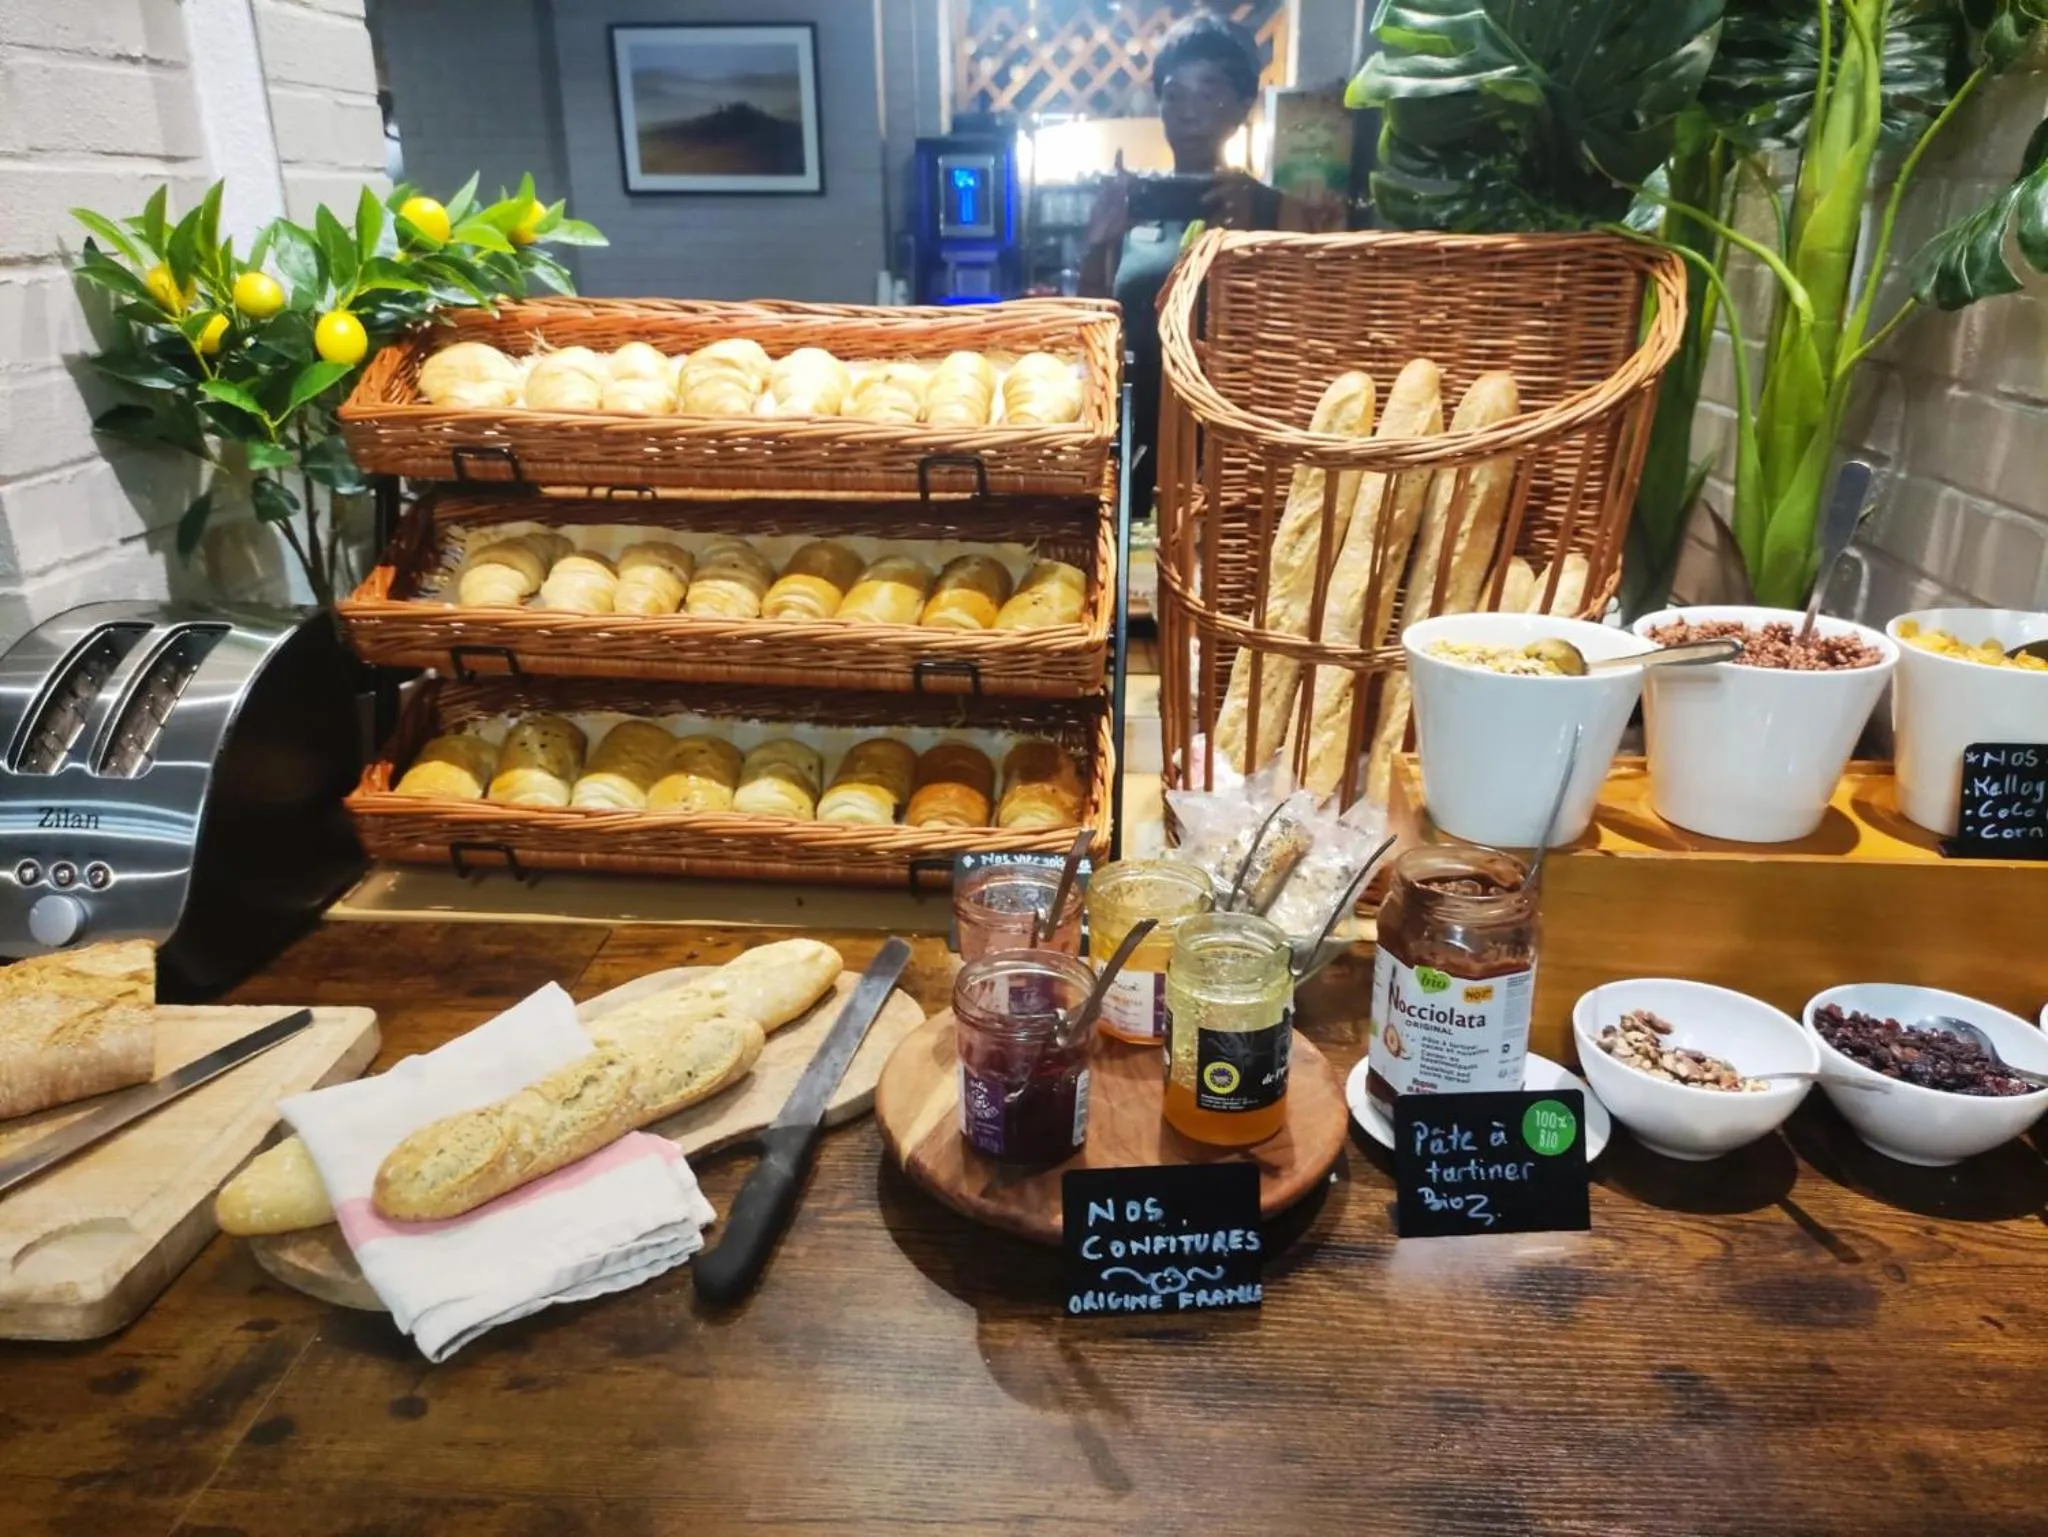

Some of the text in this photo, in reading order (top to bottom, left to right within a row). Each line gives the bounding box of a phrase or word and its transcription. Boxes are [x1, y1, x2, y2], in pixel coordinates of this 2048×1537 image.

[37, 806, 100, 830] Zilan
[1388, 981, 1487, 1030] Nocciolata
[1404, 1020, 1454, 1036] ORIGINAL
[1411, 1121, 1478, 1156] Pâte
[1539, 1129, 1559, 1149] BIO
[1426, 1158, 1535, 1183] tartiner
[1082, 1229, 1262, 1261] CONFITURES
[1068, 1290, 1163, 1314] ORIGINE
